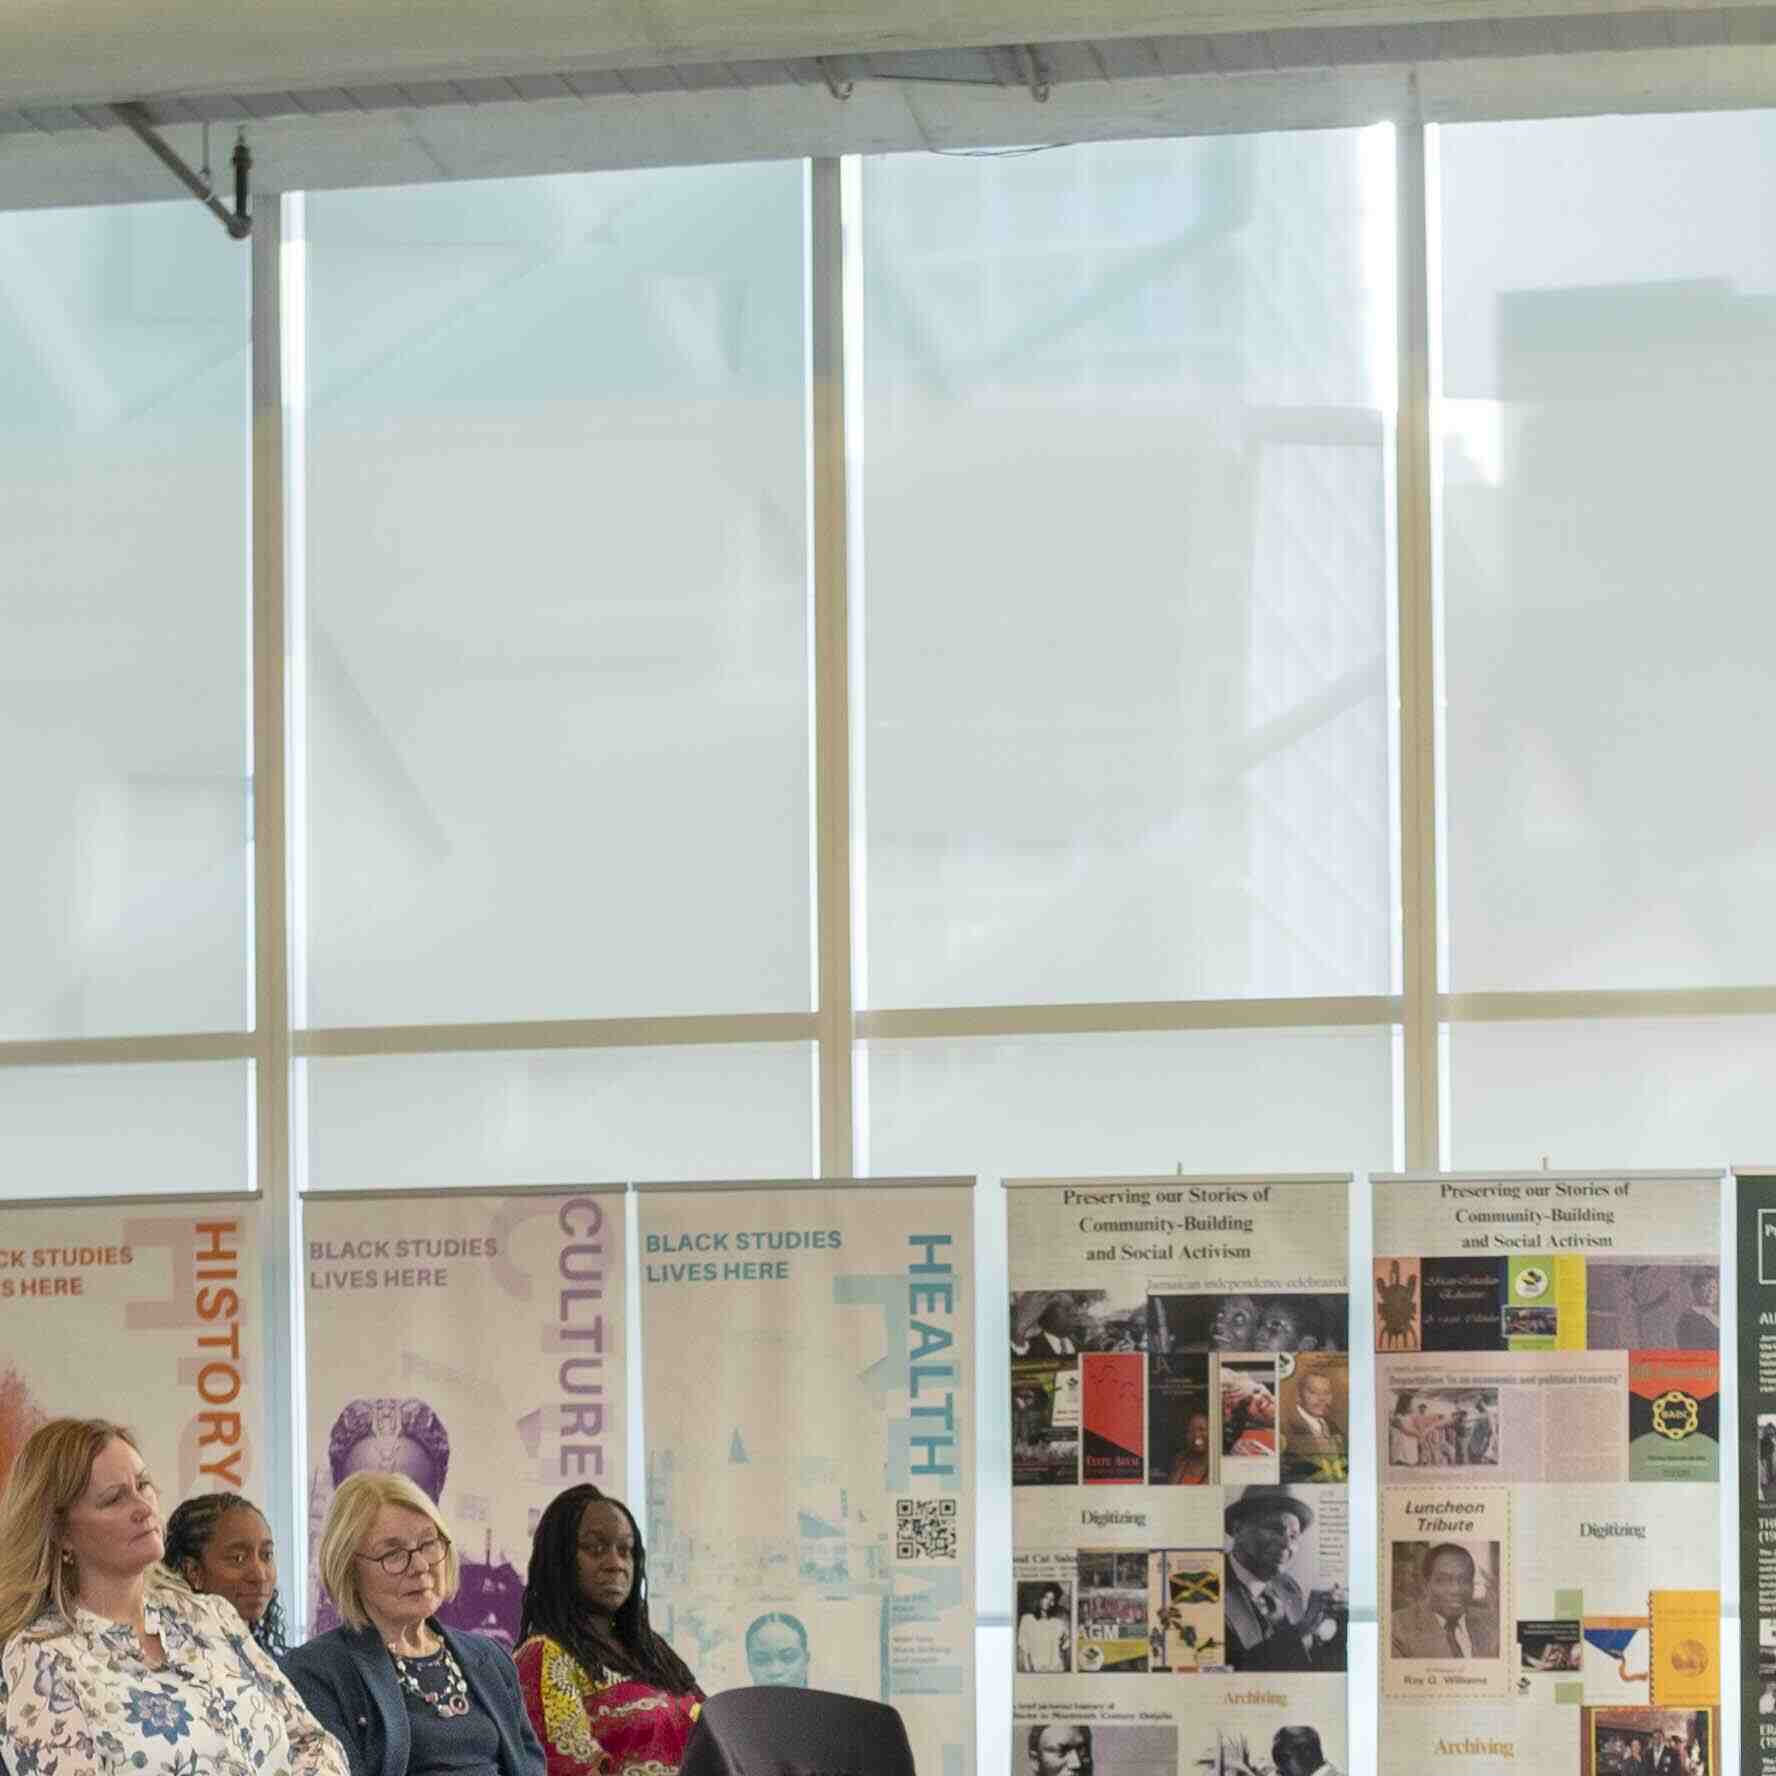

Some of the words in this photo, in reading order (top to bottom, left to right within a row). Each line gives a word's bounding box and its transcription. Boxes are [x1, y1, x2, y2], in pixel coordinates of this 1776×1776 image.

[1063, 1187, 1150, 1206] Preserving
[1156, 1190, 1183, 1203] our
[1188, 1187, 1248, 1203] Stories
[1252, 1186, 1272, 1201] of
[1440, 1183, 1521, 1200] Preserving
[1525, 1186, 1551, 1198] our
[1556, 1183, 1610, 1197] Stories
[1614, 1182, 1631, 1196] of
[1078, 1216, 1254, 1234] Community-Building
[1455, 1209, 1615, 1226] Community-Building
[310, 1239, 390, 1260] BLACK
[396, 1237, 497, 1258] STUDIES
[646, 1233, 729, 1253] BLACK
[736, 1230, 842, 1250] STUDIES
[1462, 1235, 1489, 1248] and
[1494, 1234, 1542, 1248] Social
[1547, 1233, 1613, 1247] Activism
[31, 1247, 134, 1267] STUDIES
[1085, 1246, 1116, 1261] and
[1121, 1245, 1174, 1261] Social
[1178, 1244, 1252, 1260] Activism
[311, 1271, 378, 1289] LIVES
[384, 1268, 447, 1287] HERE
[647, 1263, 717, 1283] LIVES
[724, 1261, 790, 1280] HERE
[20, 1278, 83, 1297] HERE
[559, 1198, 603, 1477] CULTURE
[194, 1222, 243, 1489] HISTORY
[908, 1234, 954, 1475] HEALTH
[1080, 1509, 1147, 1527] Digitizing
[1405, 1501, 1485, 1516] Luncheon
[1417, 1518, 1474, 1532] Tribute
[1579, 1522, 1646, 1540] Digitizing
[1224, 1691, 1289, 1707] Archiving
[1434, 1738, 1515, 1758] Archiving
